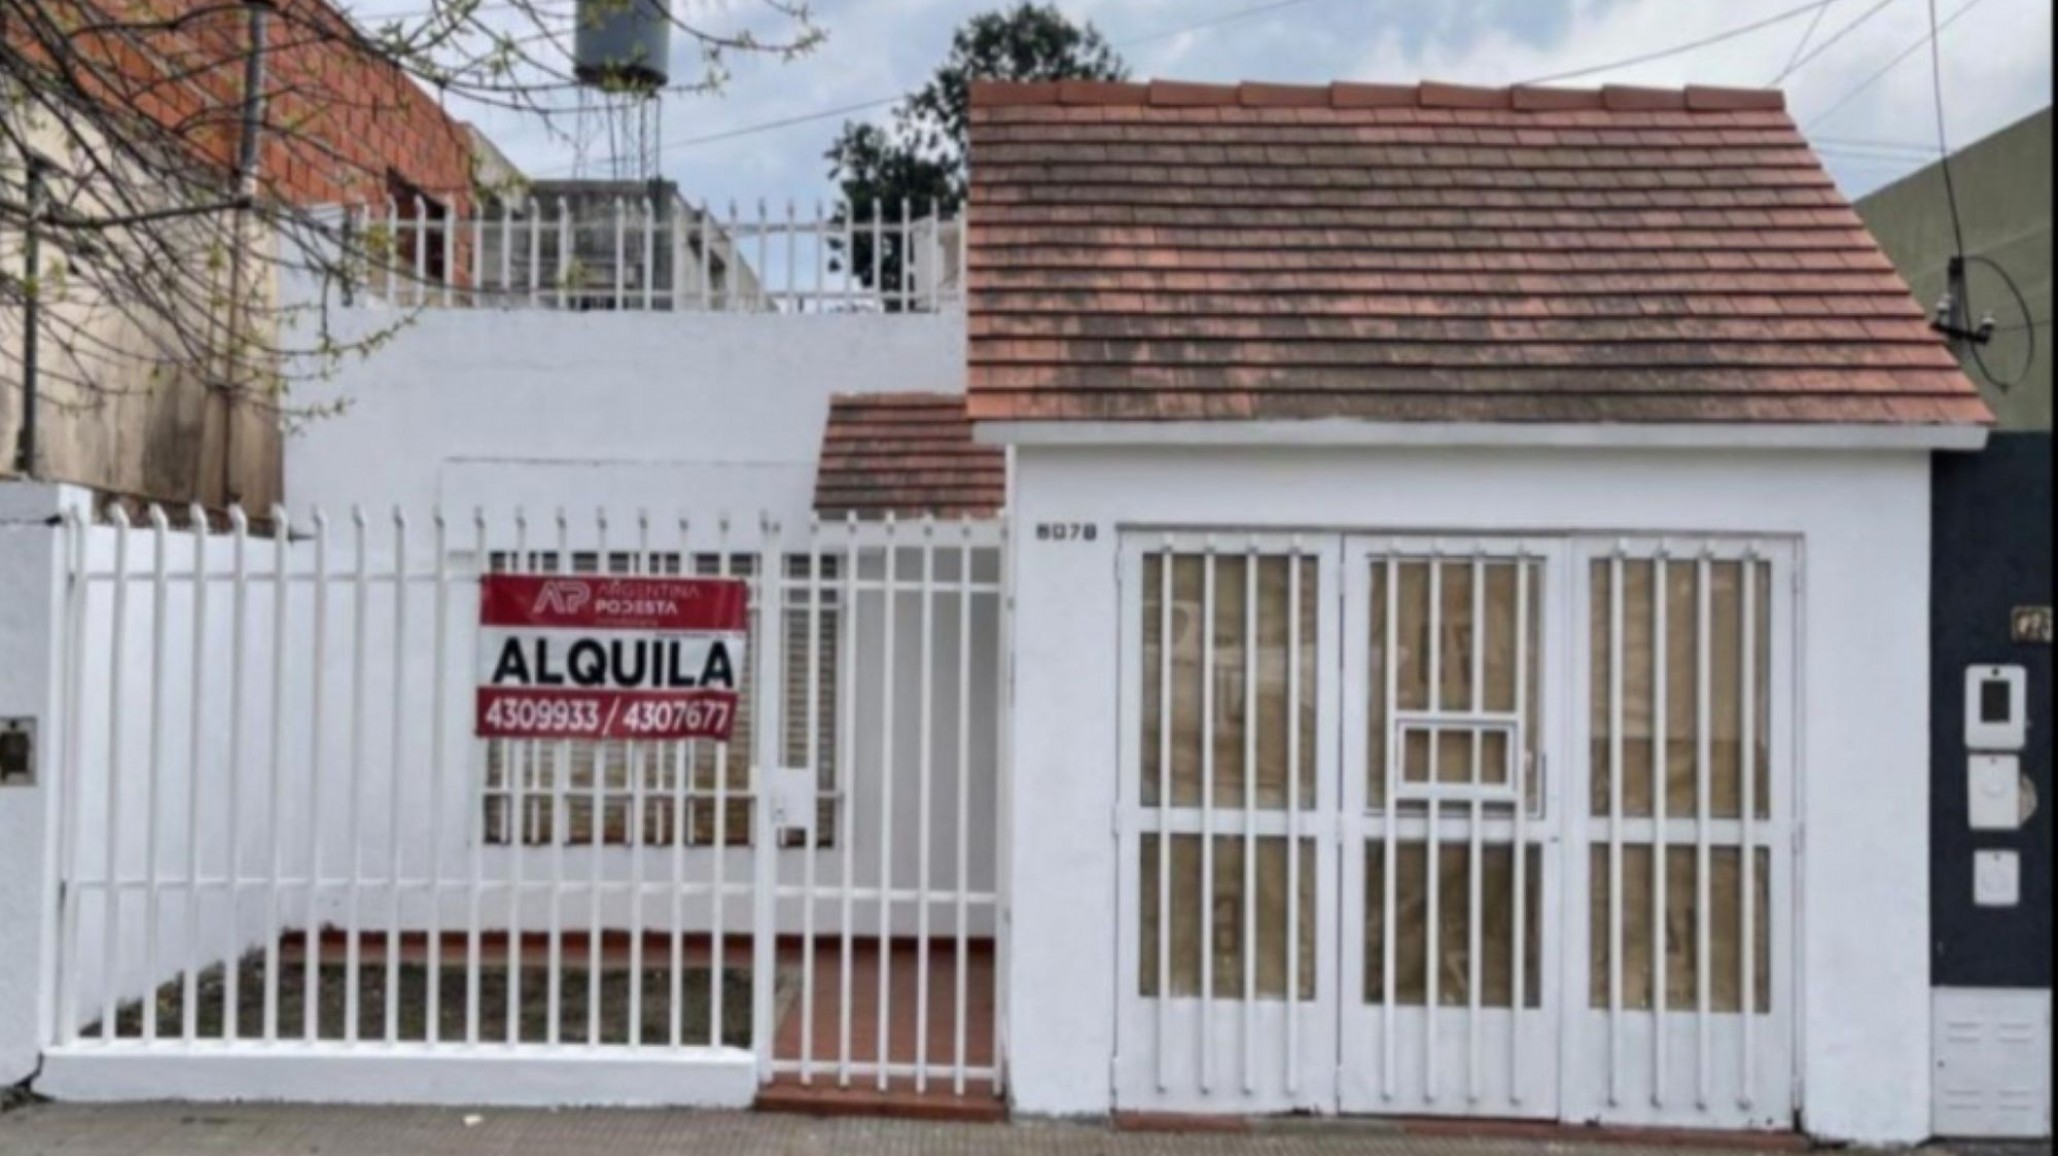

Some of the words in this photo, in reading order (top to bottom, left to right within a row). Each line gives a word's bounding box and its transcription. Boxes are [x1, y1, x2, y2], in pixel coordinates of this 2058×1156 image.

[533, 580, 592, 614] AP
[595, 581, 699, 598] ARGENTINA
[491, 636, 735, 688] ALQUILA
[485, 697, 599, 731] 4309933
[622, 700, 730, 733] 4307677
